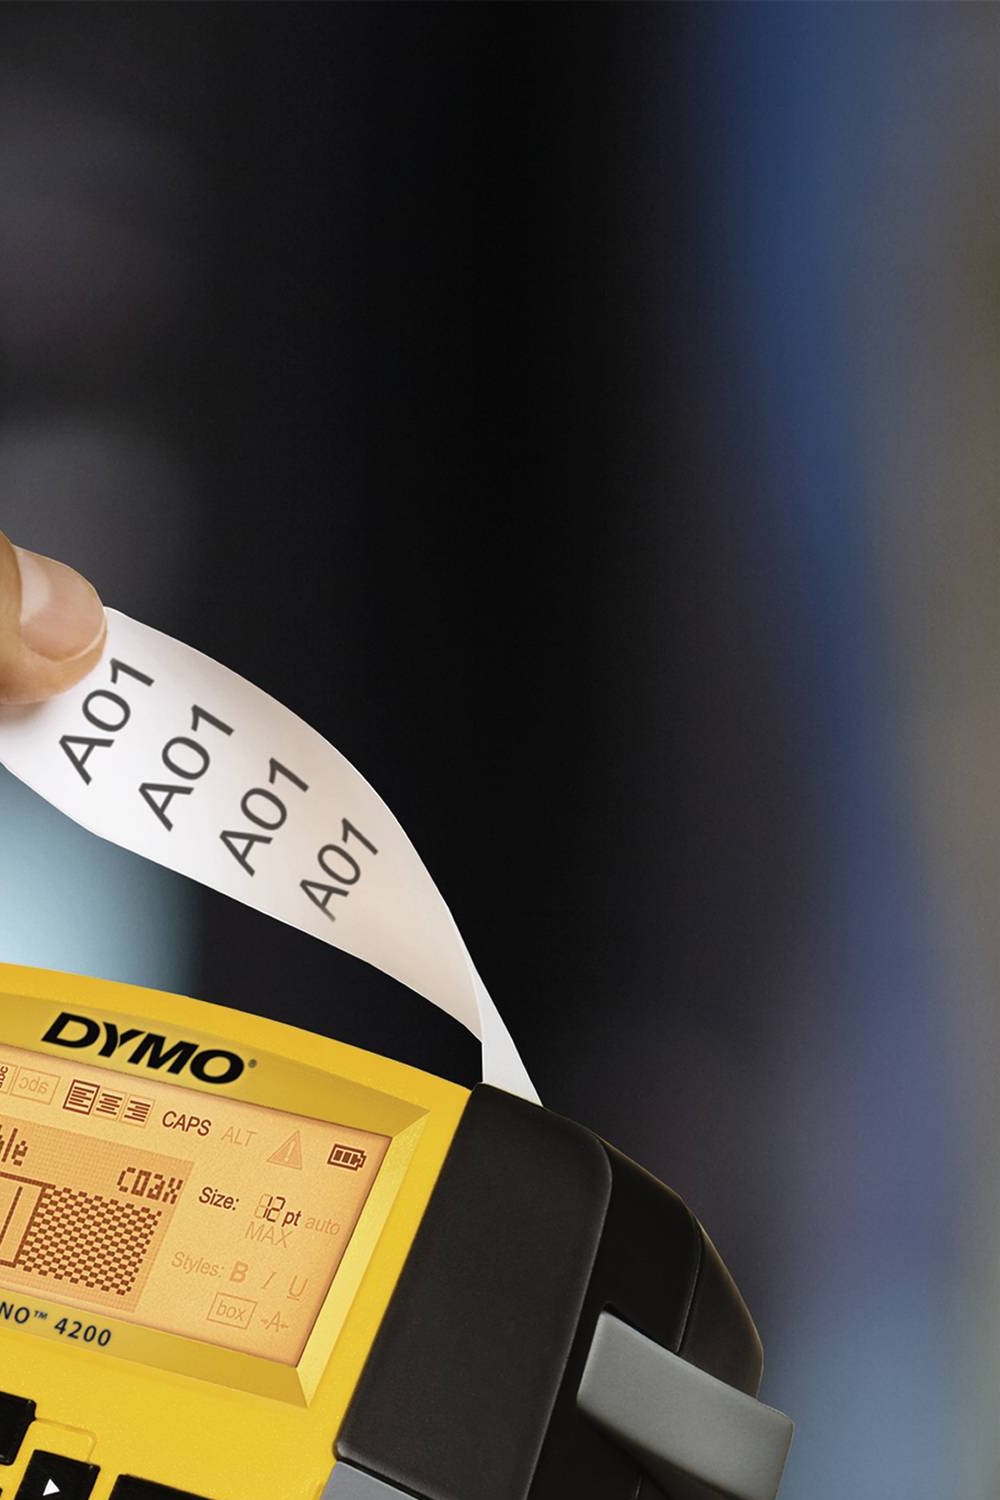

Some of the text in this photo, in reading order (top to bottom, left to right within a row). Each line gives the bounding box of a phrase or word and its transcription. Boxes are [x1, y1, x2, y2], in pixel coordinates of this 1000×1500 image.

[59, 658, 155, 785] A01
[138, 704, 235, 831] A01
[219, 758, 309, 876] A01
[299, 818, 378, 922] A01
[162, 1111, 256, 1146] CAPS ALT
[199, 1187, 239, 1210] Size:
[281, 1209, 301, 1228] pt
[305, 1215, 340, 1236] auto
[245, 1221, 293, 1248] MAX
[171, 1252, 224, 1279] Styles:
[230, 1261, 248, 1283] B
[54, 1318, 111, 1347] 4200
[216, 1302, 246, 1322] box
